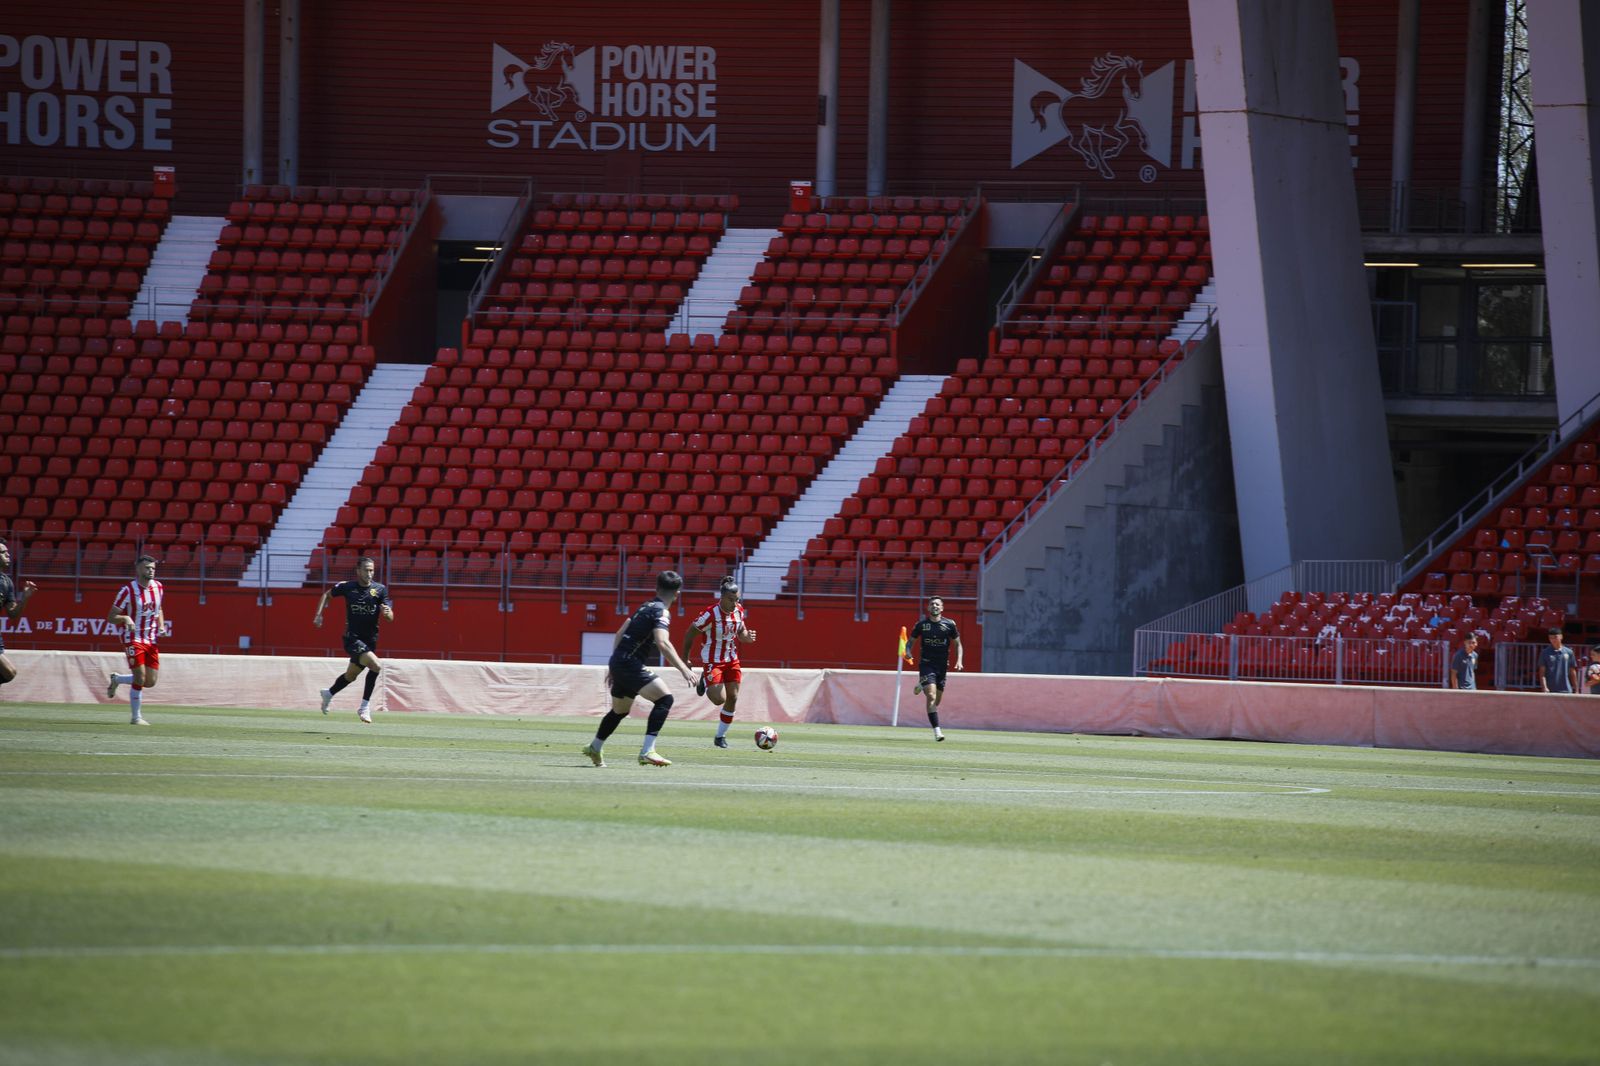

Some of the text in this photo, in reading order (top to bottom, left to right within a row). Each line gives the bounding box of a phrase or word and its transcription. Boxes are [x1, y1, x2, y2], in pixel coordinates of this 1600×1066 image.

[0, 34, 172, 94] POWER
[601, 45, 717, 81] POWER
[601, 83, 717, 118] HORSE
[0, 92, 172, 150] HORSE
[487, 119, 717, 151] STADIUM
[36, 621, 53, 630] DE
[55, 617, 173, 637] LEVAE
